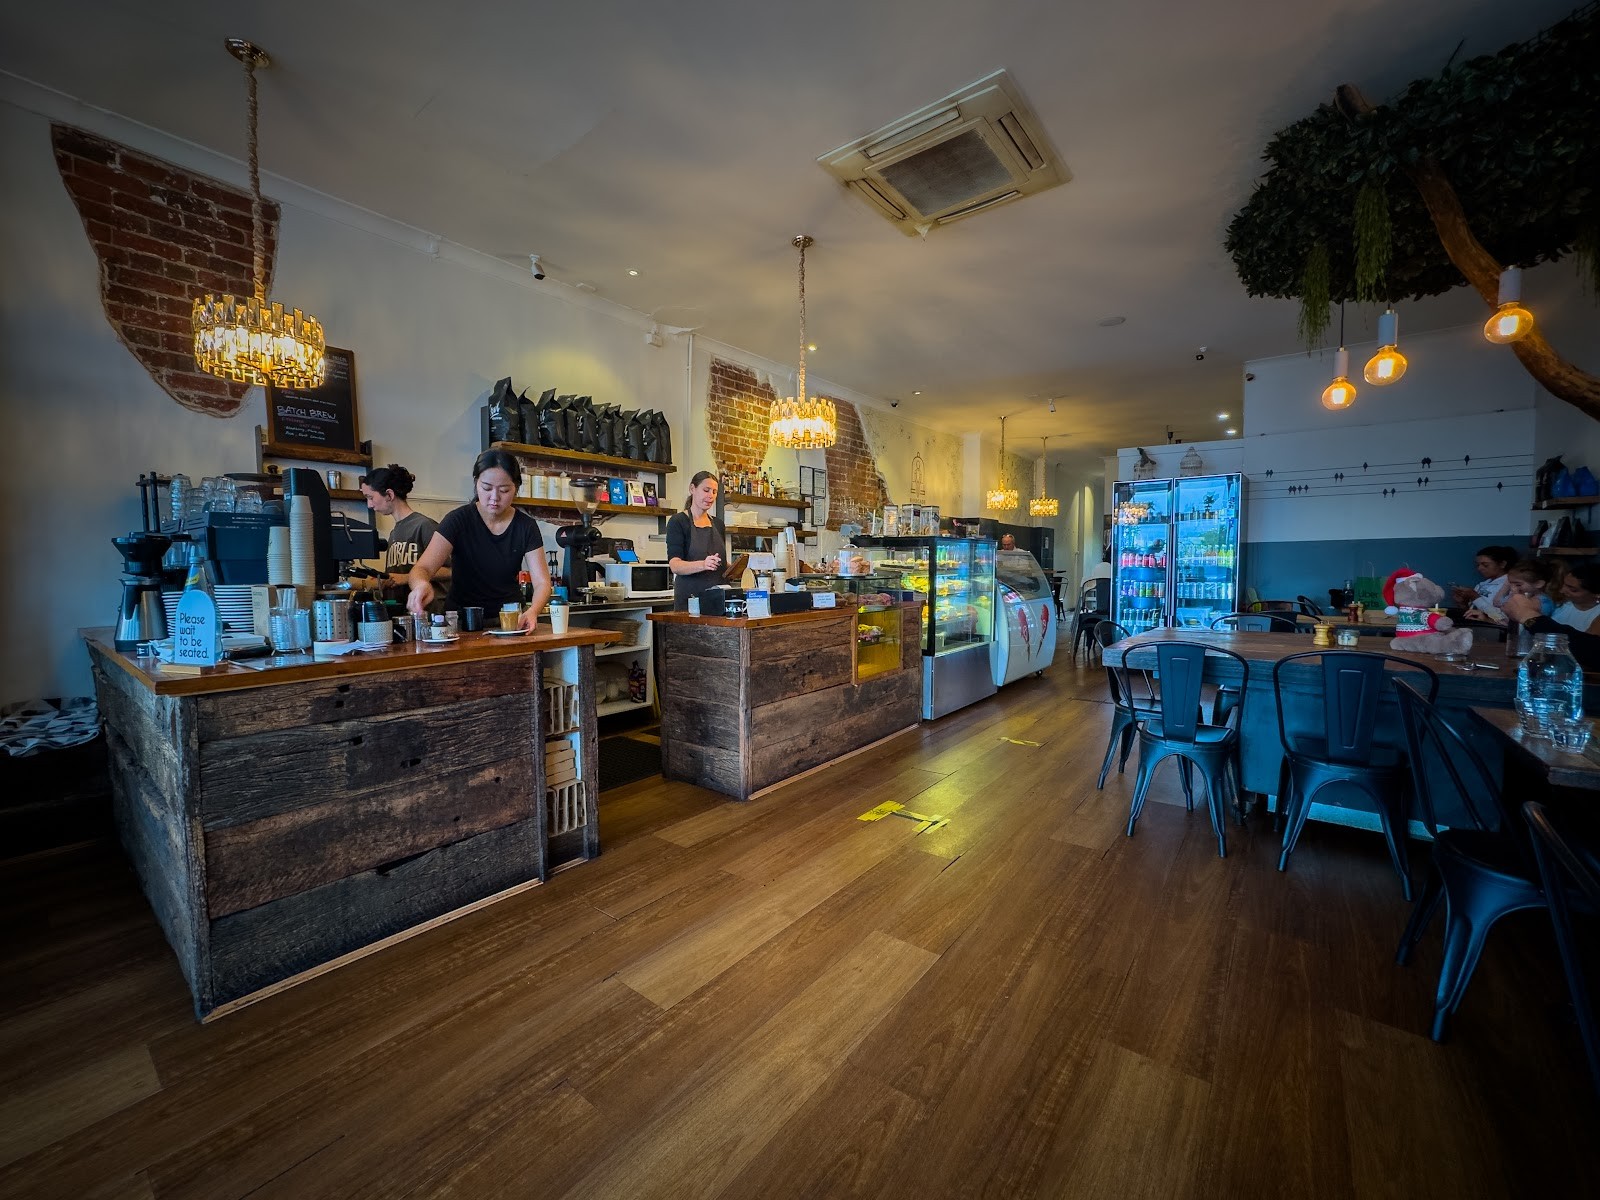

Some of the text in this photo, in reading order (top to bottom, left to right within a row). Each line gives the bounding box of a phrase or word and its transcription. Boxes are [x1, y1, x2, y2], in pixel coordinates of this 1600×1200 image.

[277, 405, 306, 416] BATCH
[309, 408, 336, 420] BREW
[180, 613, 205, 625] Please
[180, 626, 195, 635] wait
[179, 635, 202, 647] to be
[179, 648, 209, 659] seated.
